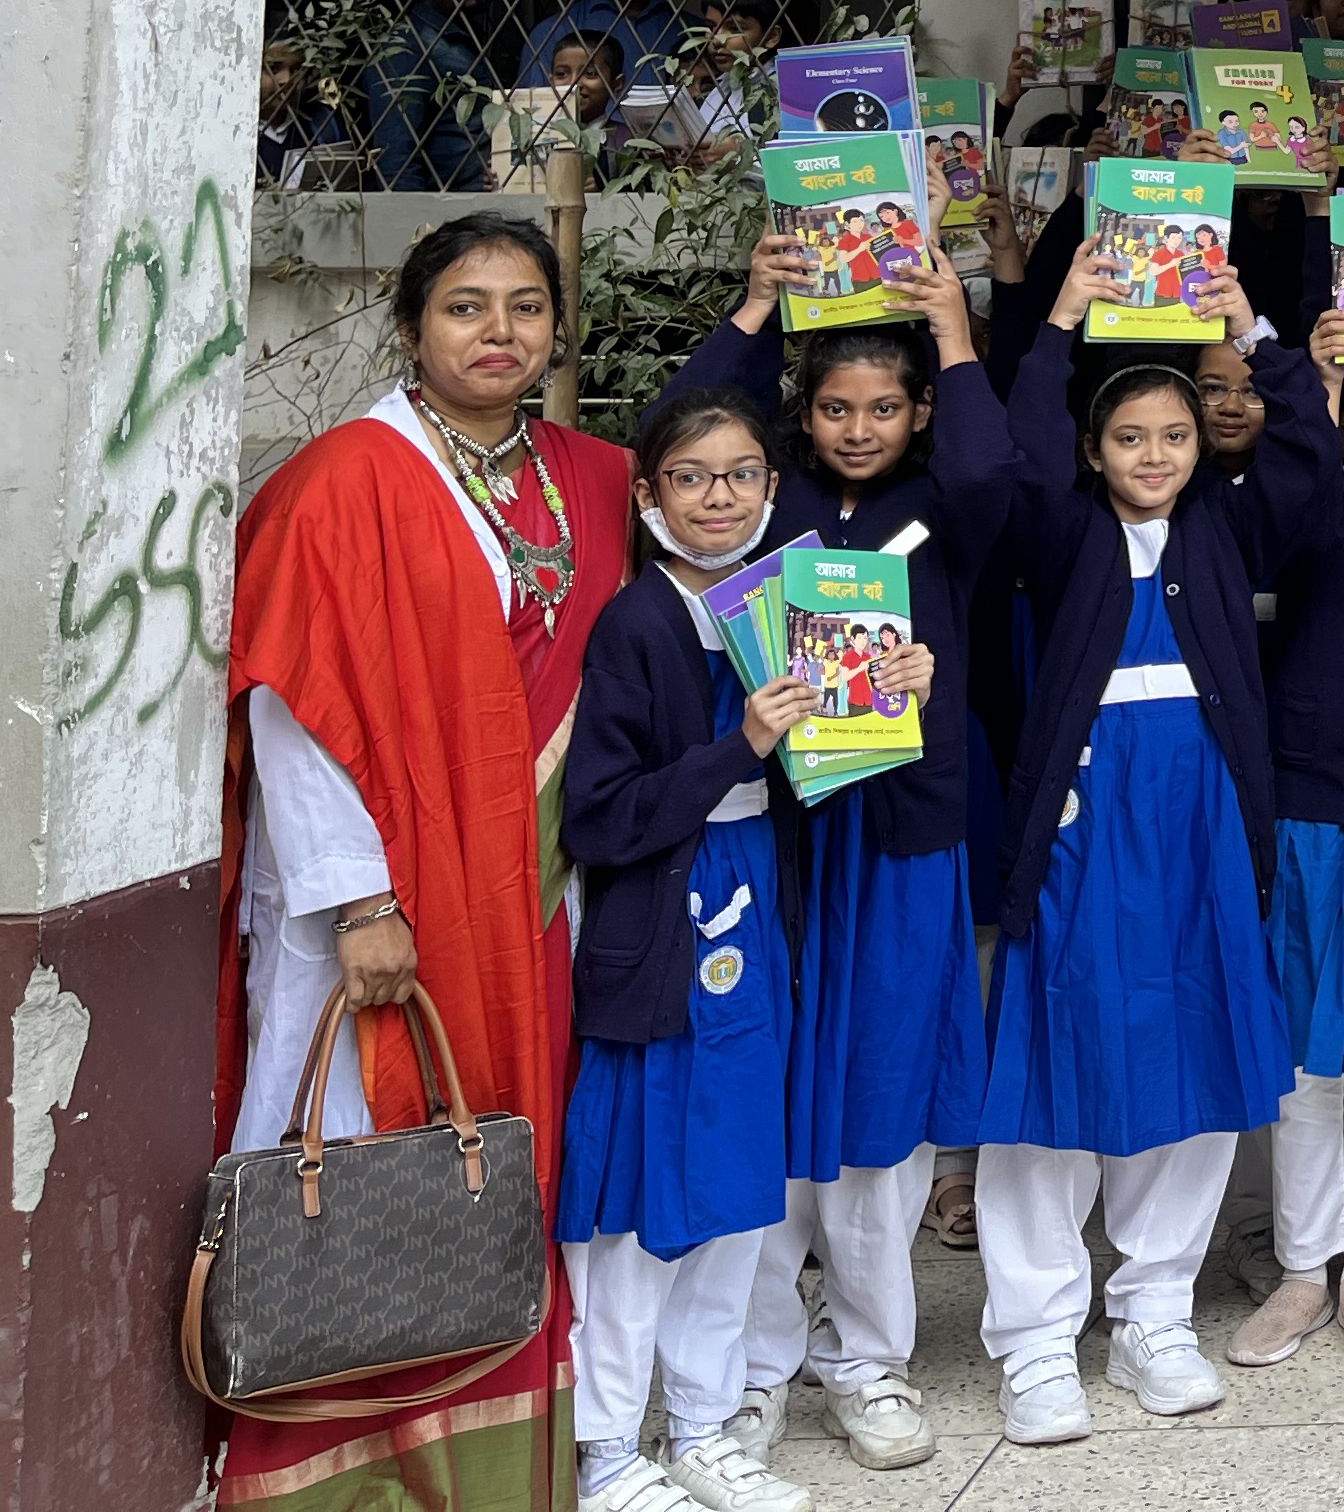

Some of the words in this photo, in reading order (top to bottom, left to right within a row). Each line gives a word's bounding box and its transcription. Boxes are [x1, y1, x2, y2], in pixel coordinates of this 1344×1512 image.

[805, 67, 851, 78] Elementary
[852, 65, 884, 75] Science
[1224, 68, 1275, 79] ENGLISH
[1230, 78, 1246, 86] FOR
[1276, 85, 1294, 104] 4
[793, 155, 840, 173] আমার
[799, 172, 847, 191] বাংলা
[849, 164, 878, 185] বই
[1130, 168, 1175, 184] আমার
[1131, 185, 1177, 203] বাংলা
[1180, 185, 1205, 205] বই
[814, 562, 857, 579] আমার
[815, 580, 859, 600] বাংলা
[861, 580, 884, 602] বই
